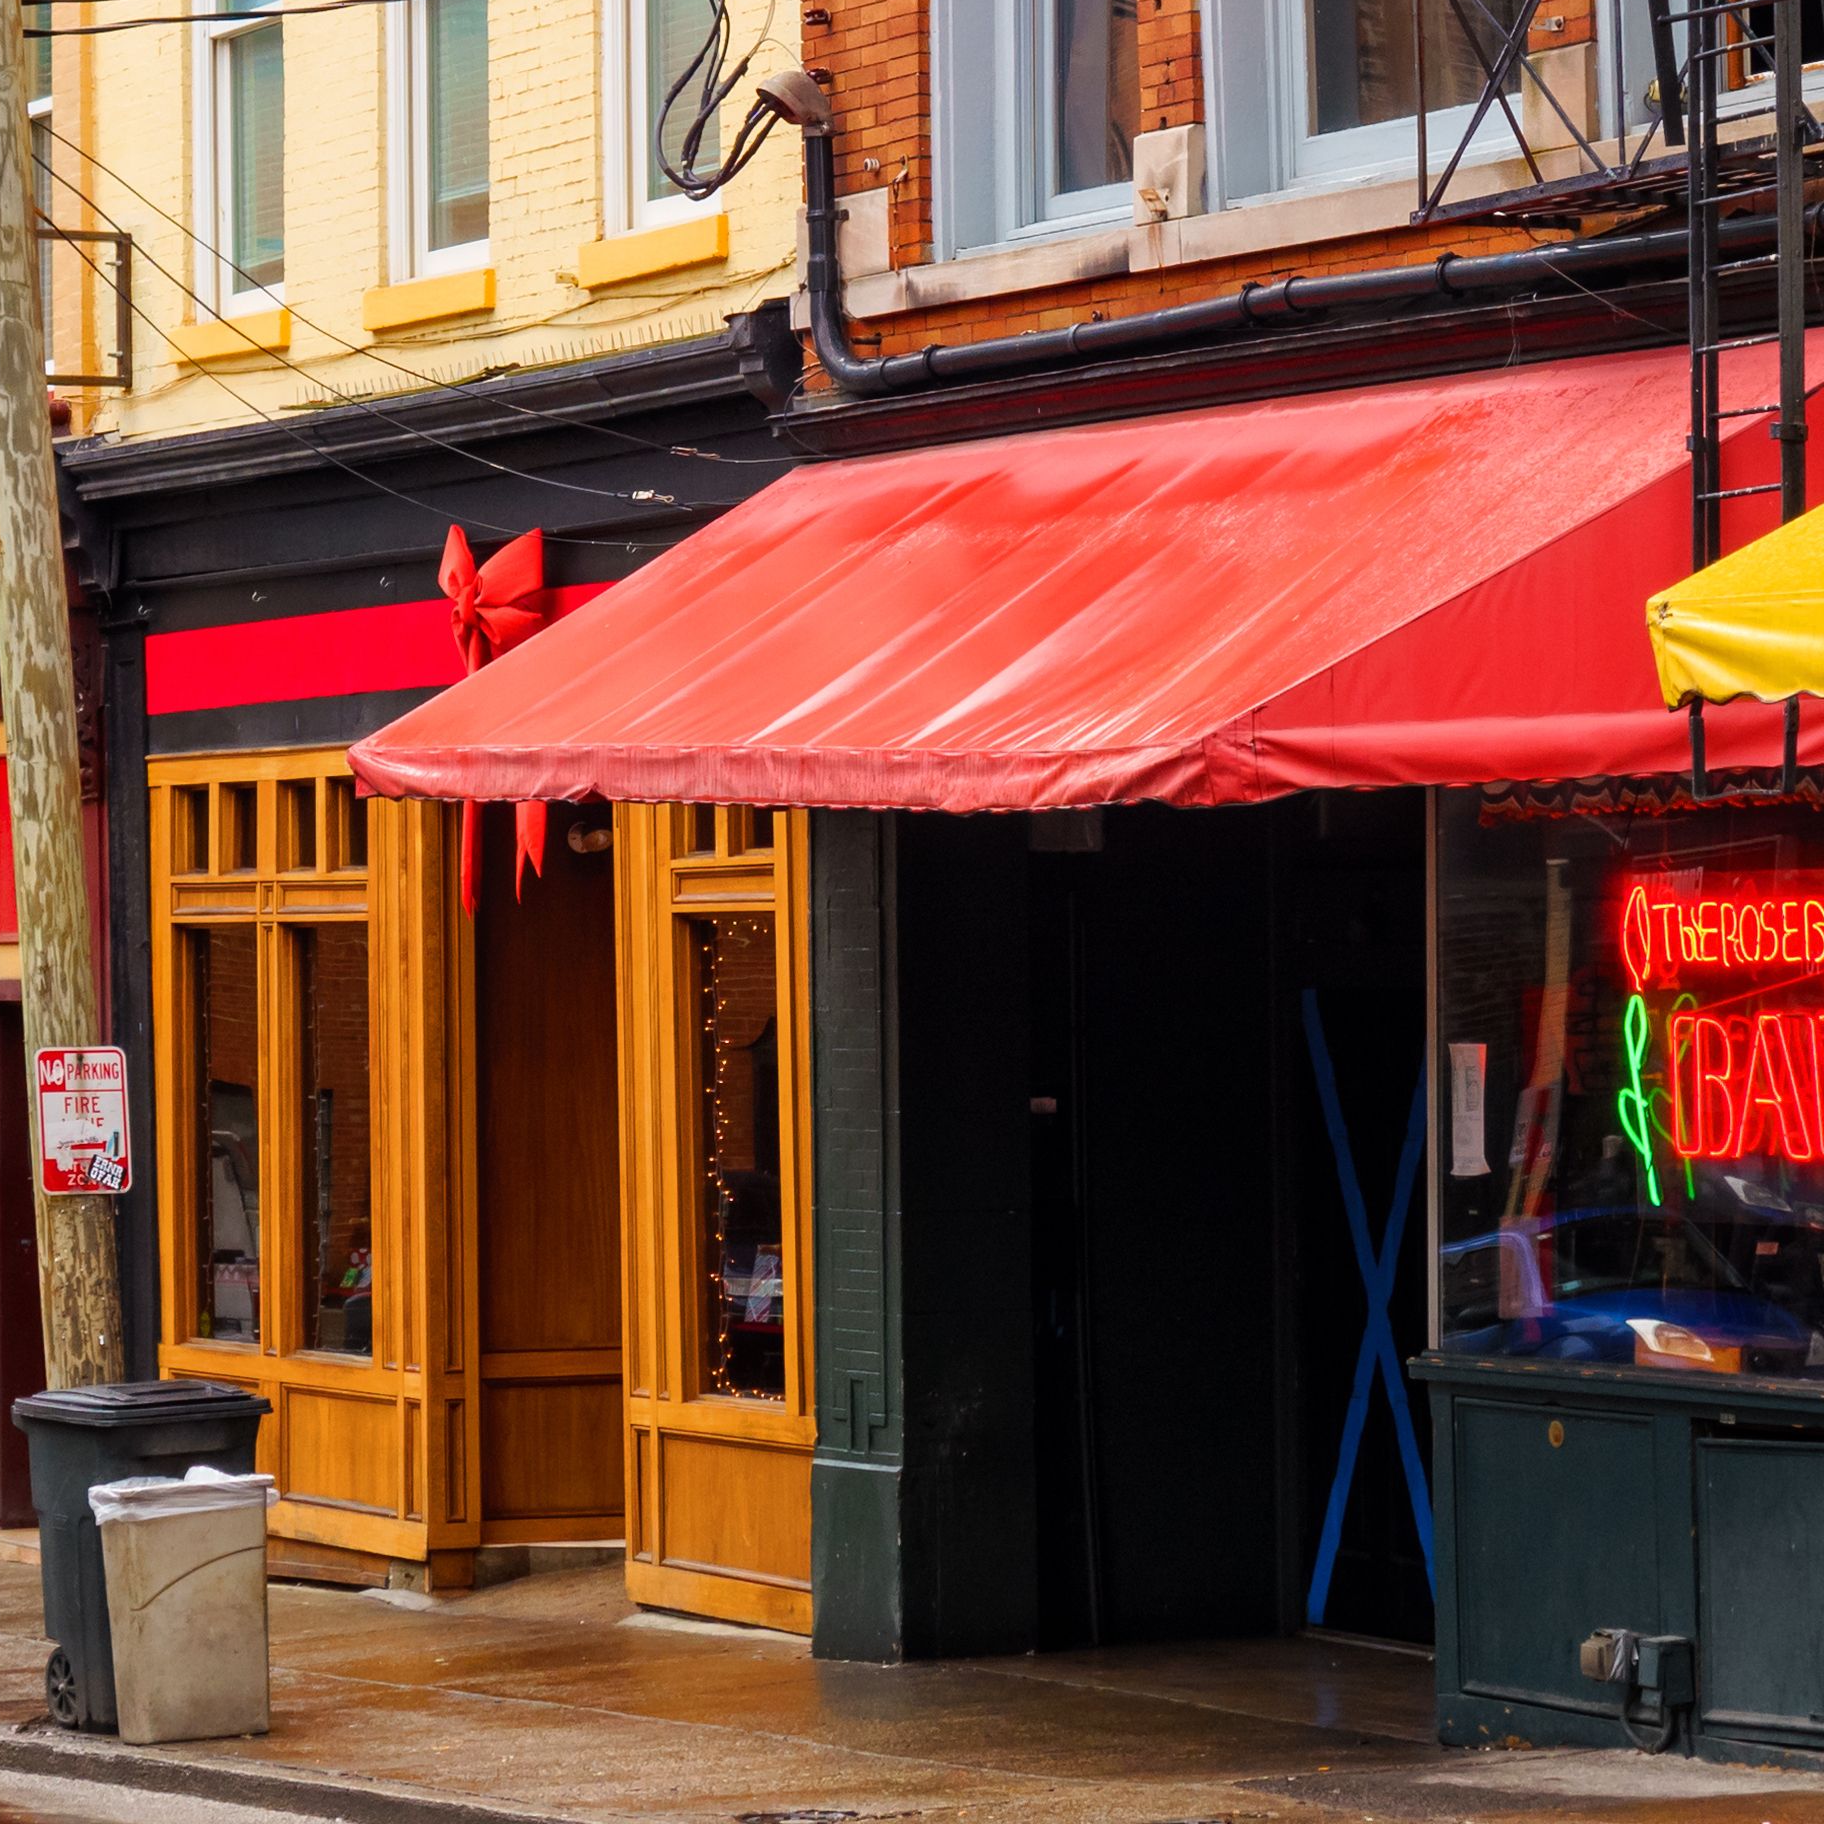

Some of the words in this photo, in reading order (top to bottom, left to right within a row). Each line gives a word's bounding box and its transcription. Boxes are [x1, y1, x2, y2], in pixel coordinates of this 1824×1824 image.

[39, 1059, 65, 1086] NO
[67, 1062, 120, 1081] PARKING
[64, 1096, 101, 1114] FIRE
